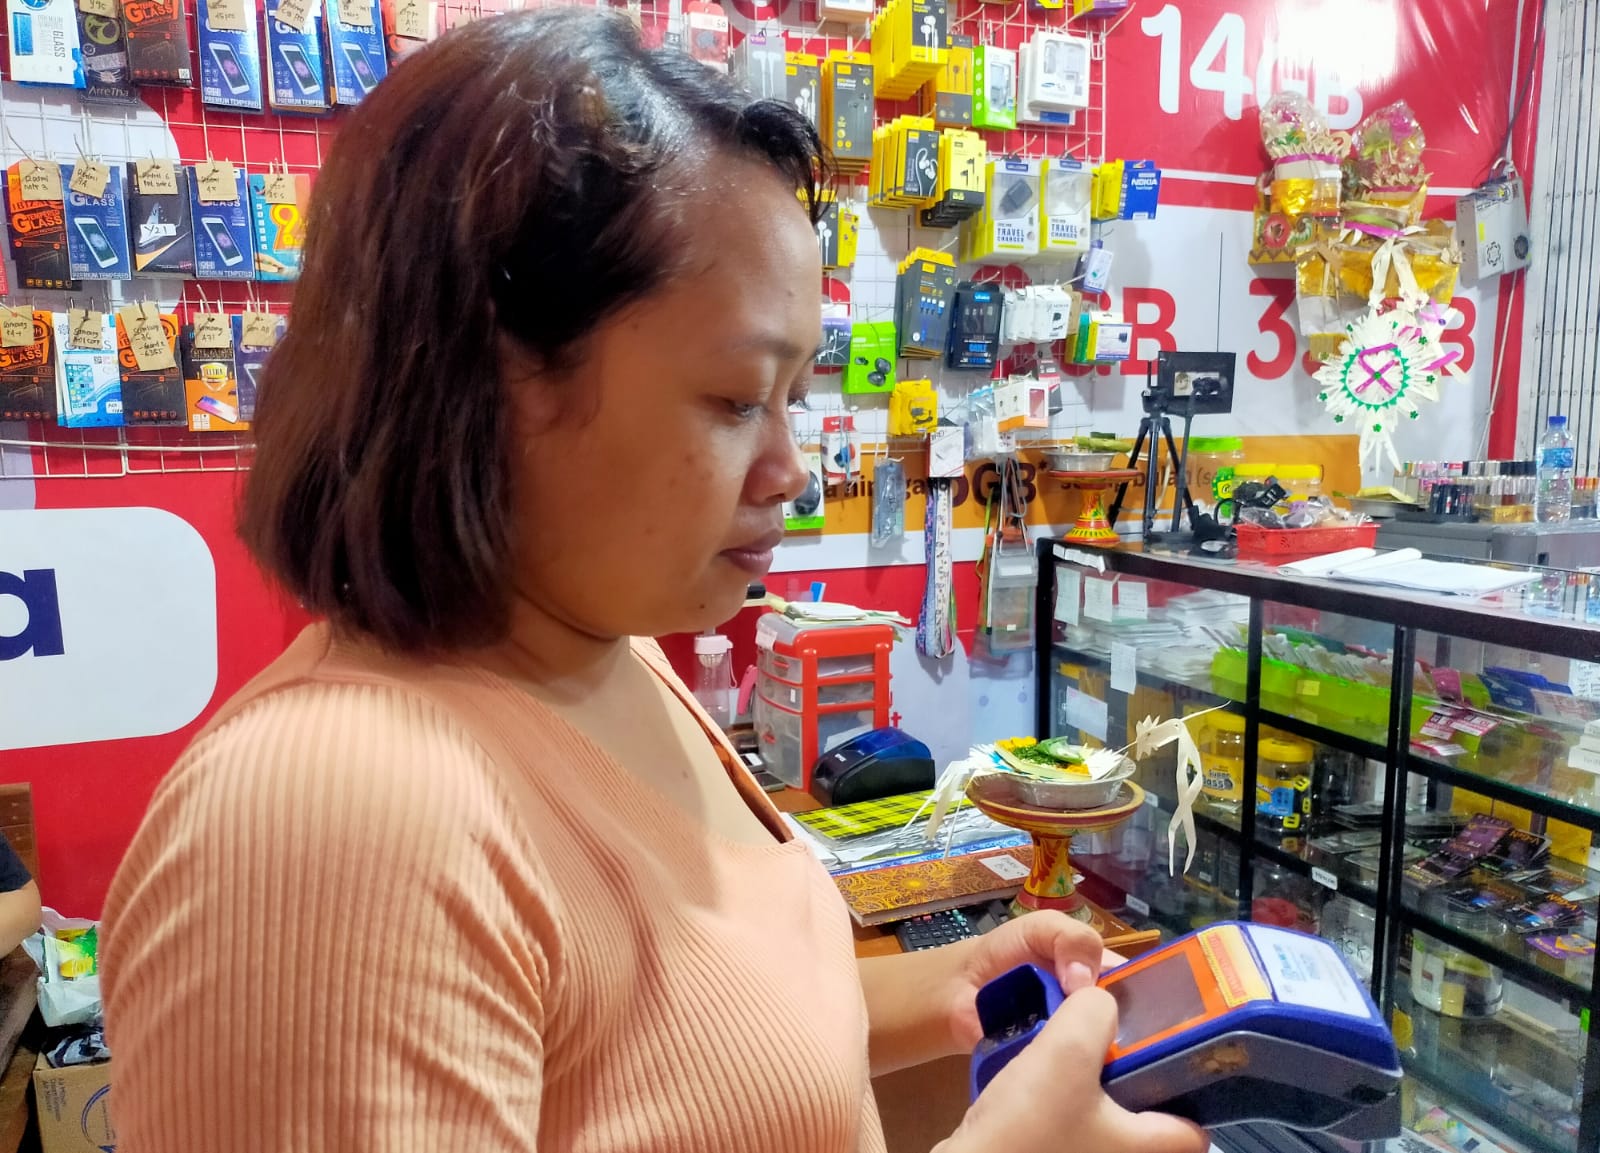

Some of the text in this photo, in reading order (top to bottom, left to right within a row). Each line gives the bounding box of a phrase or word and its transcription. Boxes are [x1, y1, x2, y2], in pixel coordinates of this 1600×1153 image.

[1131, 177, 1157, 186] NOKIA
[70, 192, 115, 206] GLASS
[12, 213, 62, 233] GLASS
[997, 228, 1025, 237] TRAVEL
[1051, 224, 1078, 233] TRAVEL
